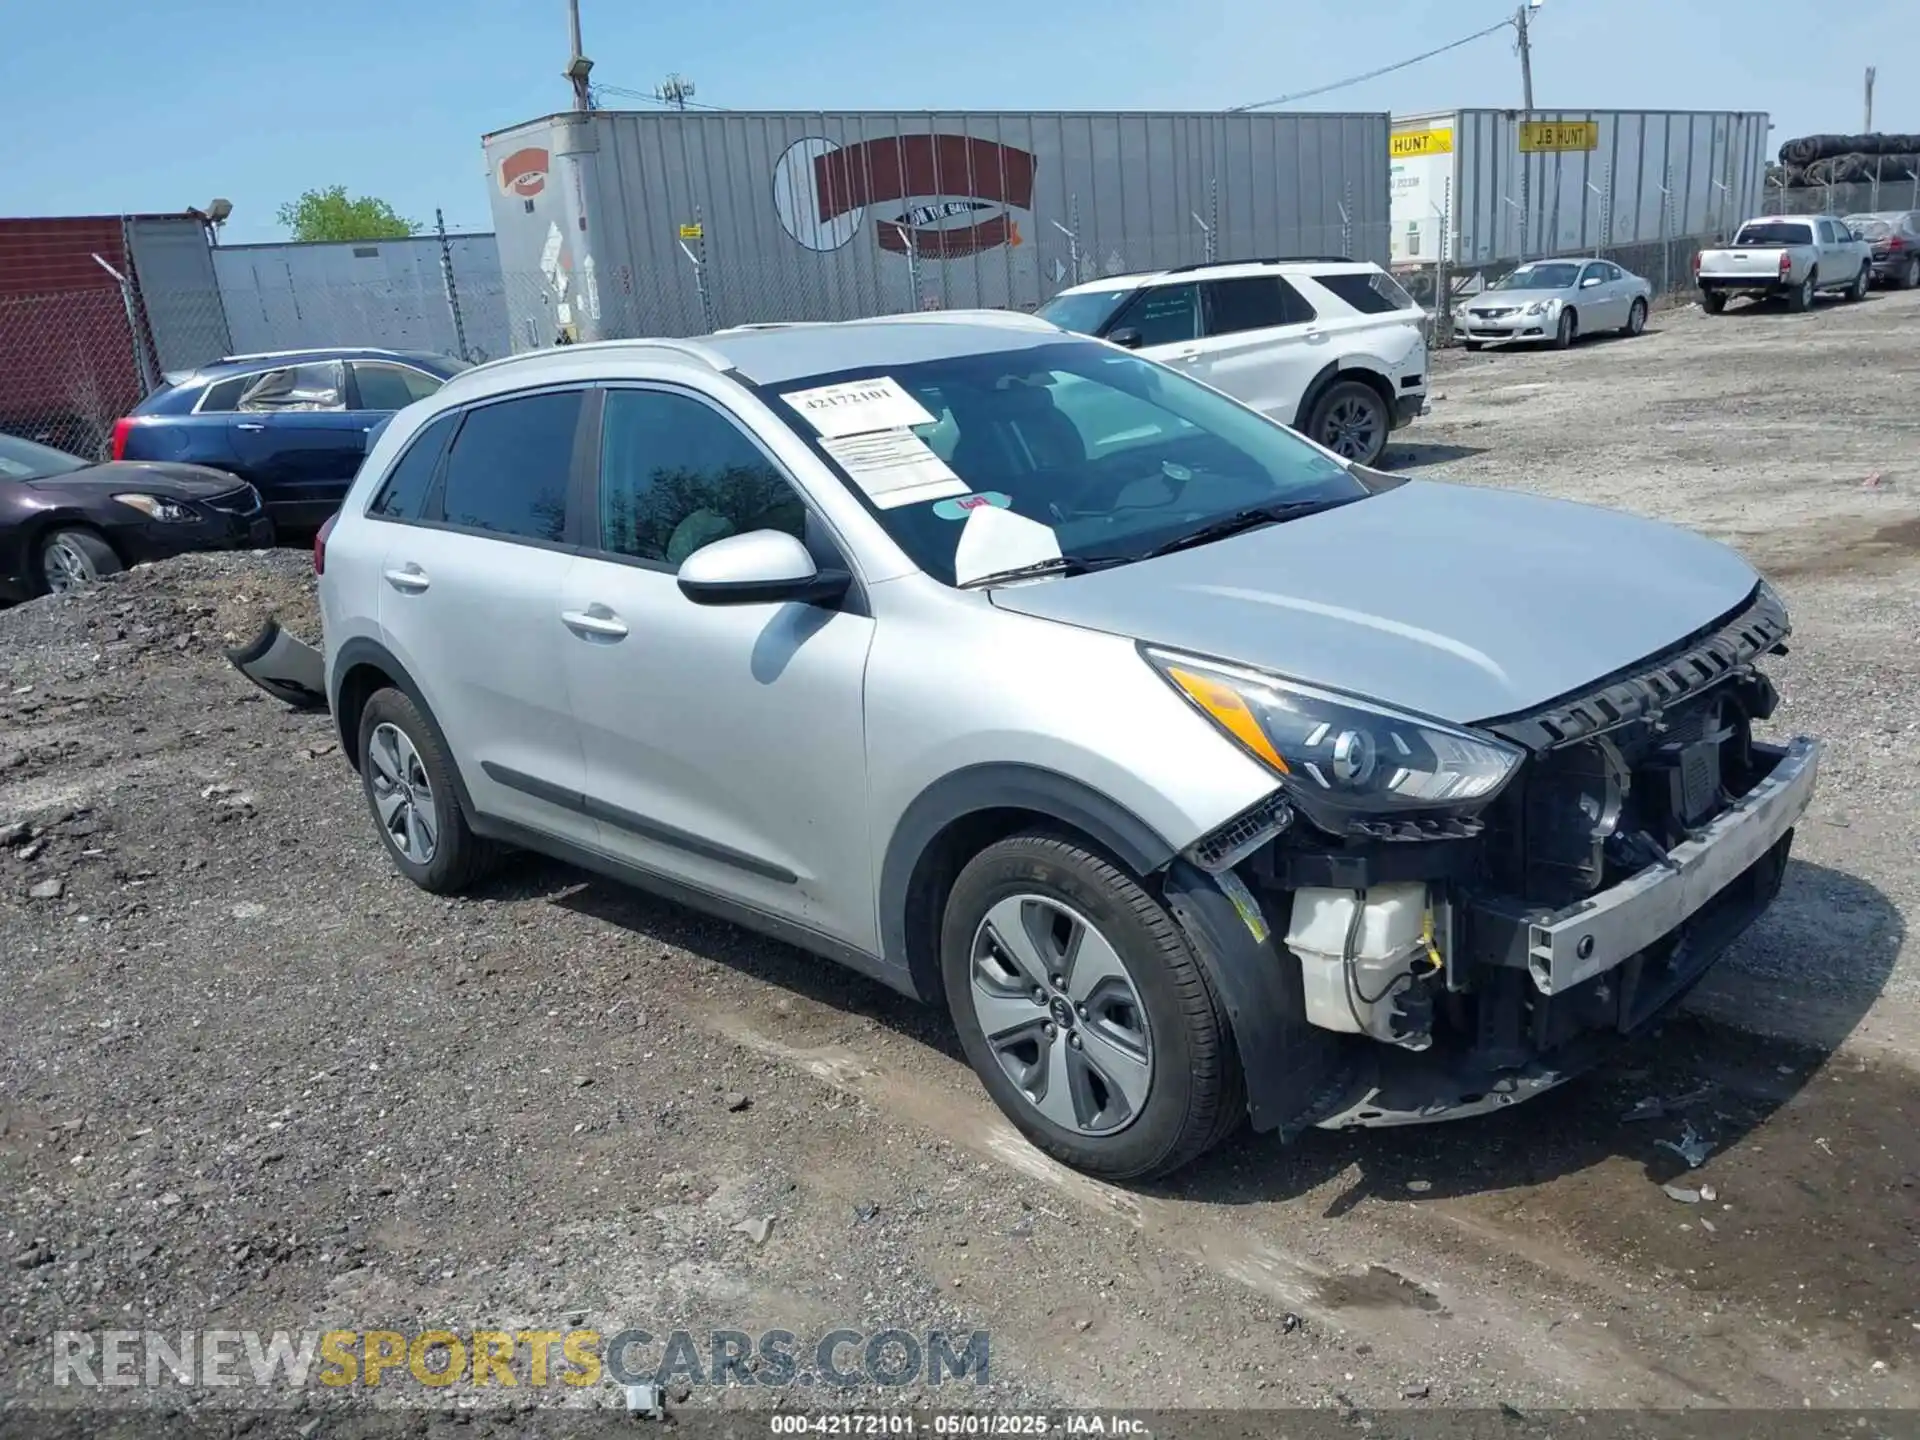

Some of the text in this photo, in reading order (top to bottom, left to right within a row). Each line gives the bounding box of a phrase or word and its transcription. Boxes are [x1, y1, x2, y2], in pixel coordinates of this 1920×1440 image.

[1394, 135, 1430, 153] HUNT
[1557, 127, 1584, 145] HUNT
[806, 388, 892, 409] 42172101
